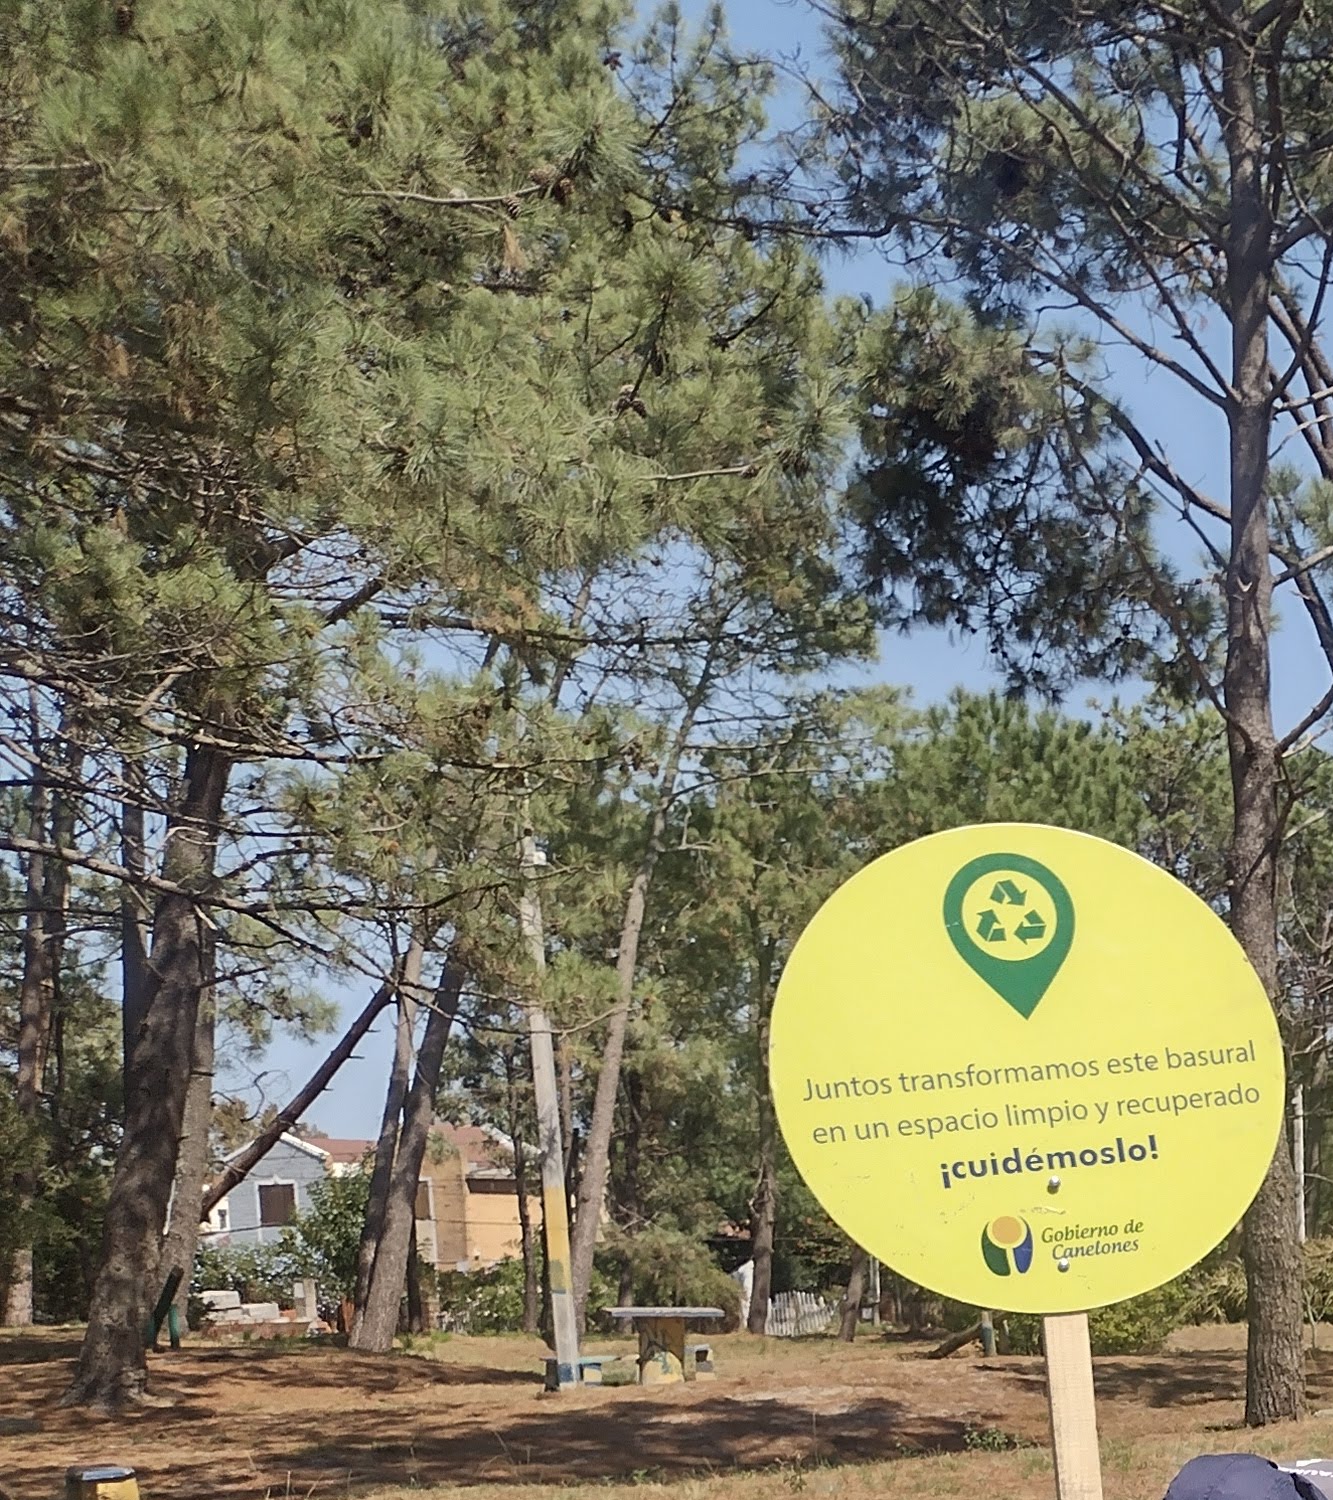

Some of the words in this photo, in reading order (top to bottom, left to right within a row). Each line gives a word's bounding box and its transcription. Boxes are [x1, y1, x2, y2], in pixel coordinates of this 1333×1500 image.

[803, 1076, 892, 1101] Juntos
[898, 1058, 1100, 1093] transformamos
[1107, 1052, 1159, 1075] este
[1165, 1039, 1256, 1070] basural
[813, 1125, 846, 1144] en
[855, 1121, 890, 1140] un
[898, 1108, 998, 1139] espacio
[1005, 1099, 1088, 1128] limpio
[1094, 1101, 1109, 1124] y
[1117, 1083, 1260, 1116] recuperado
[940, 1134, 1159, 1189] ¡cuidémoslo!
[1041, 1223, 1119, 1243] Gobierno
[1123, 1219, 1144, 1234] de
[1052, 1239, 1139, 1260] Canelones
